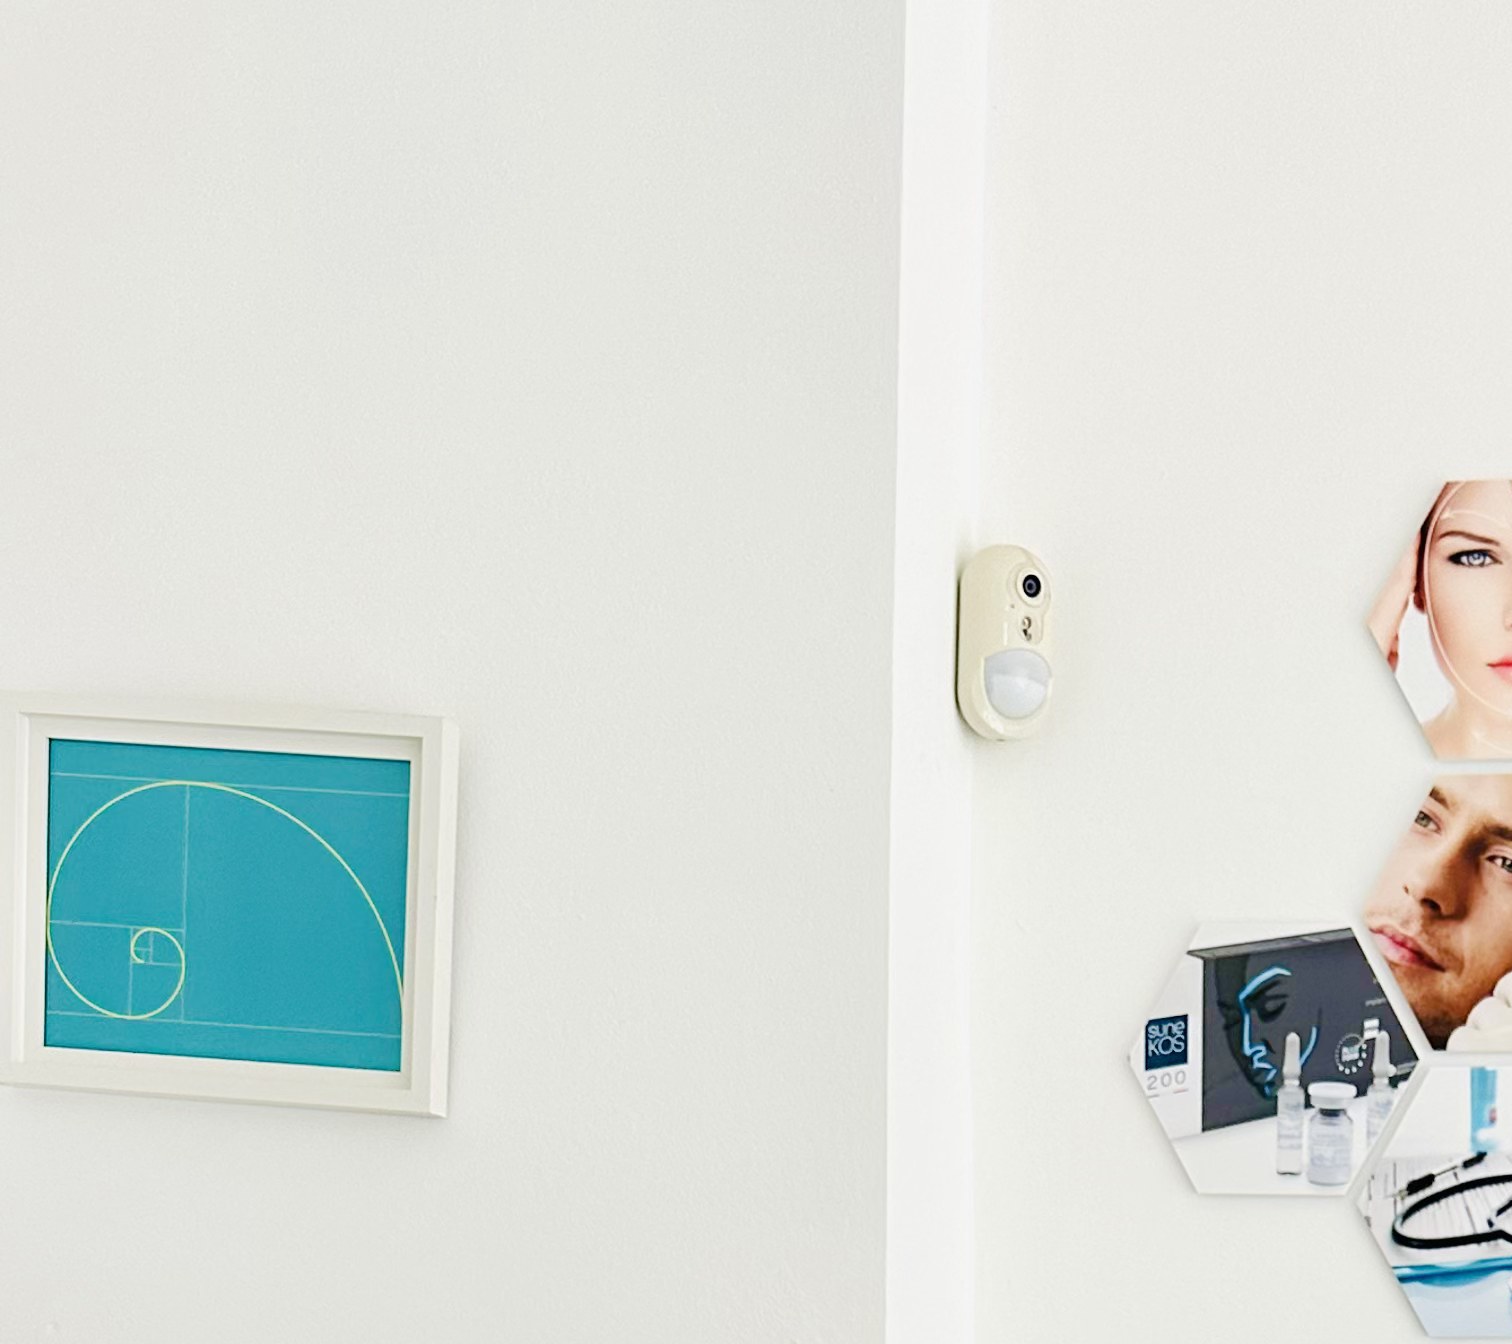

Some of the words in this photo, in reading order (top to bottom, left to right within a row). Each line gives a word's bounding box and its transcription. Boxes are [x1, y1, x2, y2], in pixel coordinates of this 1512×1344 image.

[1147, 1021, 1185, 1039] sune
[1148, 1035, 1185, 1057] KOS
[1147, 1070, 1187, 1091] 200
